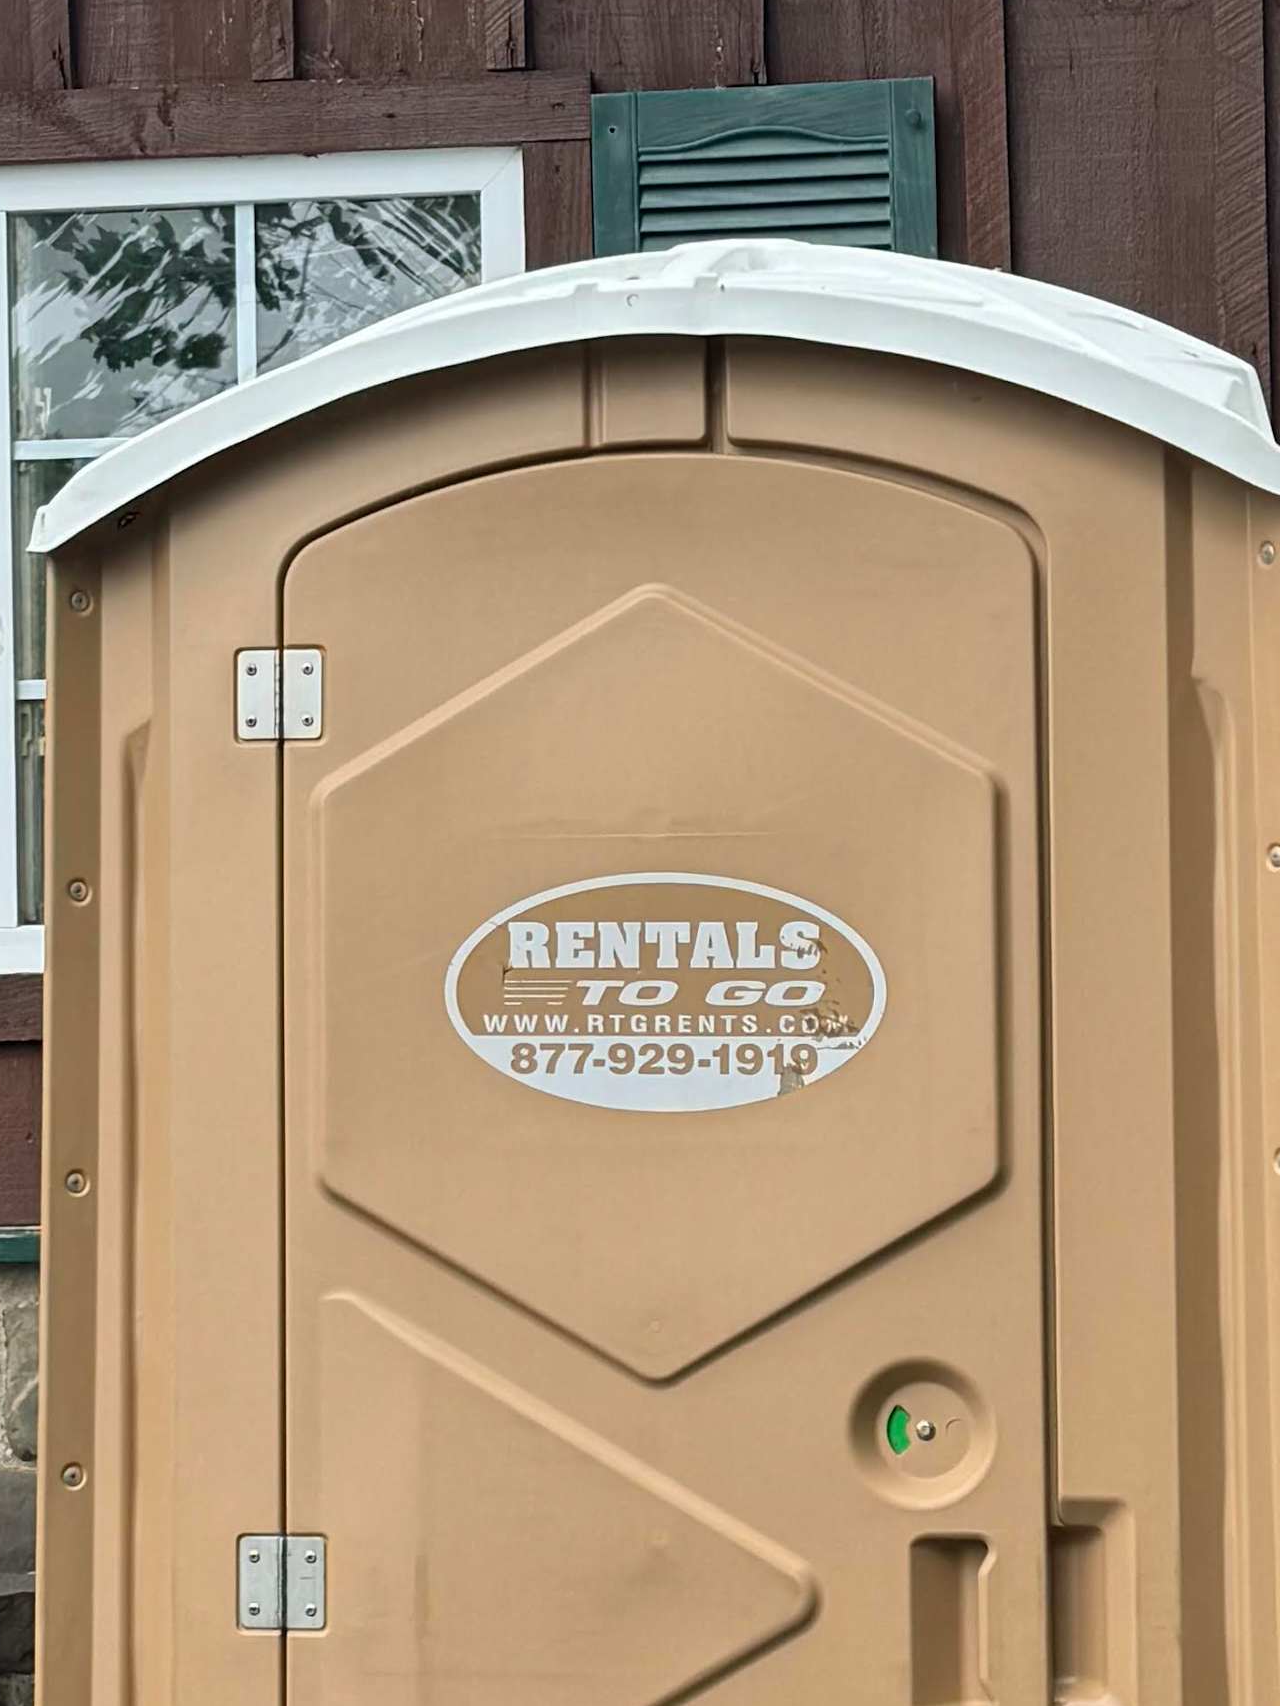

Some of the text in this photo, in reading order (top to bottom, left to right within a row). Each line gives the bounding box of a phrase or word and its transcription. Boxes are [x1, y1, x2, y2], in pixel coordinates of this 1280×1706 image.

[508, 921, 821, 970] RENTALS
[575, 979, 826, 1007] TO GO
[509, 1043, 819, 1076] 877-929-1919
